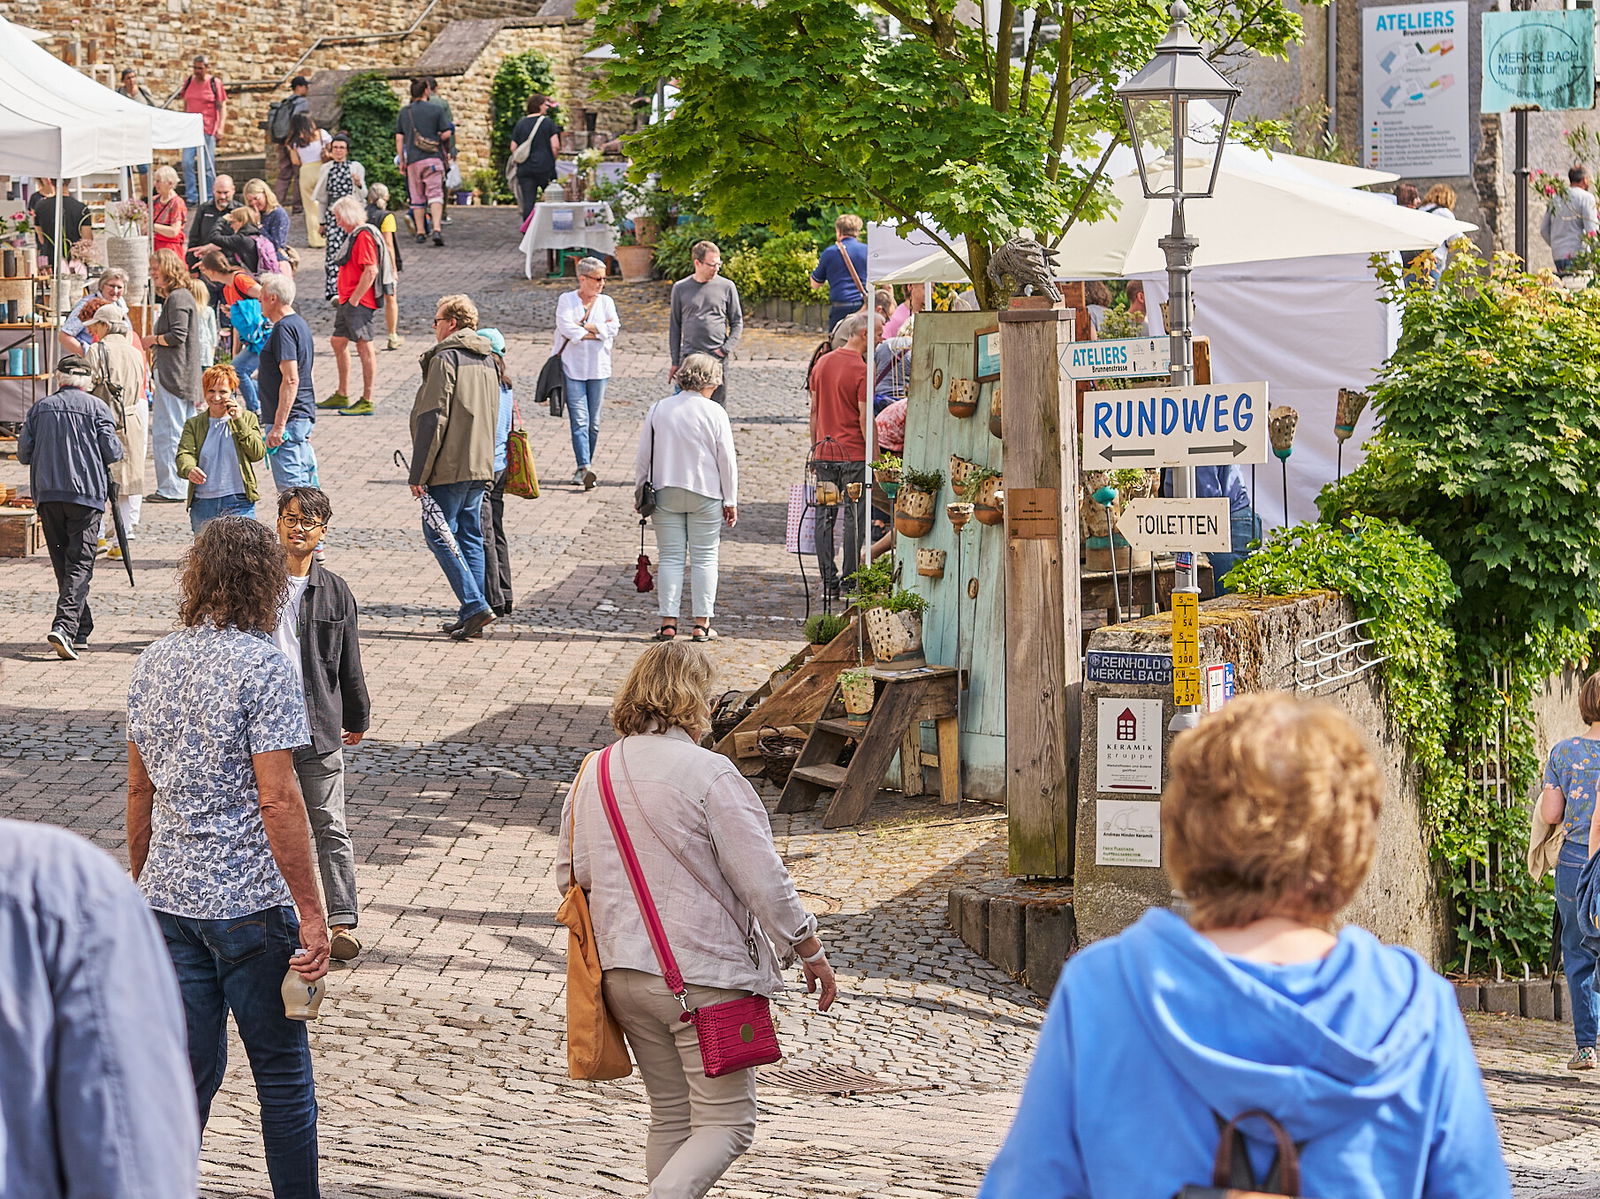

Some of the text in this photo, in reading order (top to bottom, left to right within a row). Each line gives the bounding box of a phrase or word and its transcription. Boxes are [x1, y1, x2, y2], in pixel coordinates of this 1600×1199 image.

[1376, 10, 1455, 31] ATELIERS
[1403, 28, 1454, 37] Brunnenstrasse
[1498, 50, 1579, 64] MERKELBACH
[1498, 64, 1556, 75] Manufaktur
[1072, 345, 1128, 367] ATELIERS
[1092, 365, 1128, 373] Brunnenstrasse
[1093, 392, 1254, 439] RUNDWEG
[1136, 514, 1218, 535] TOILETTEN
[1183, 619, 1193, 627] 54
[1101, 656, 1161, 670] REINHOLD
[1178, 655, 1193, 664] 300
[1091, 667, 1172, 682] MERKELBACH
[1185, 693, 1195, 702] 37
[1106, 743, 1153, 751] KERAMIK
[1106, 753, 1153, 761] gruppe
